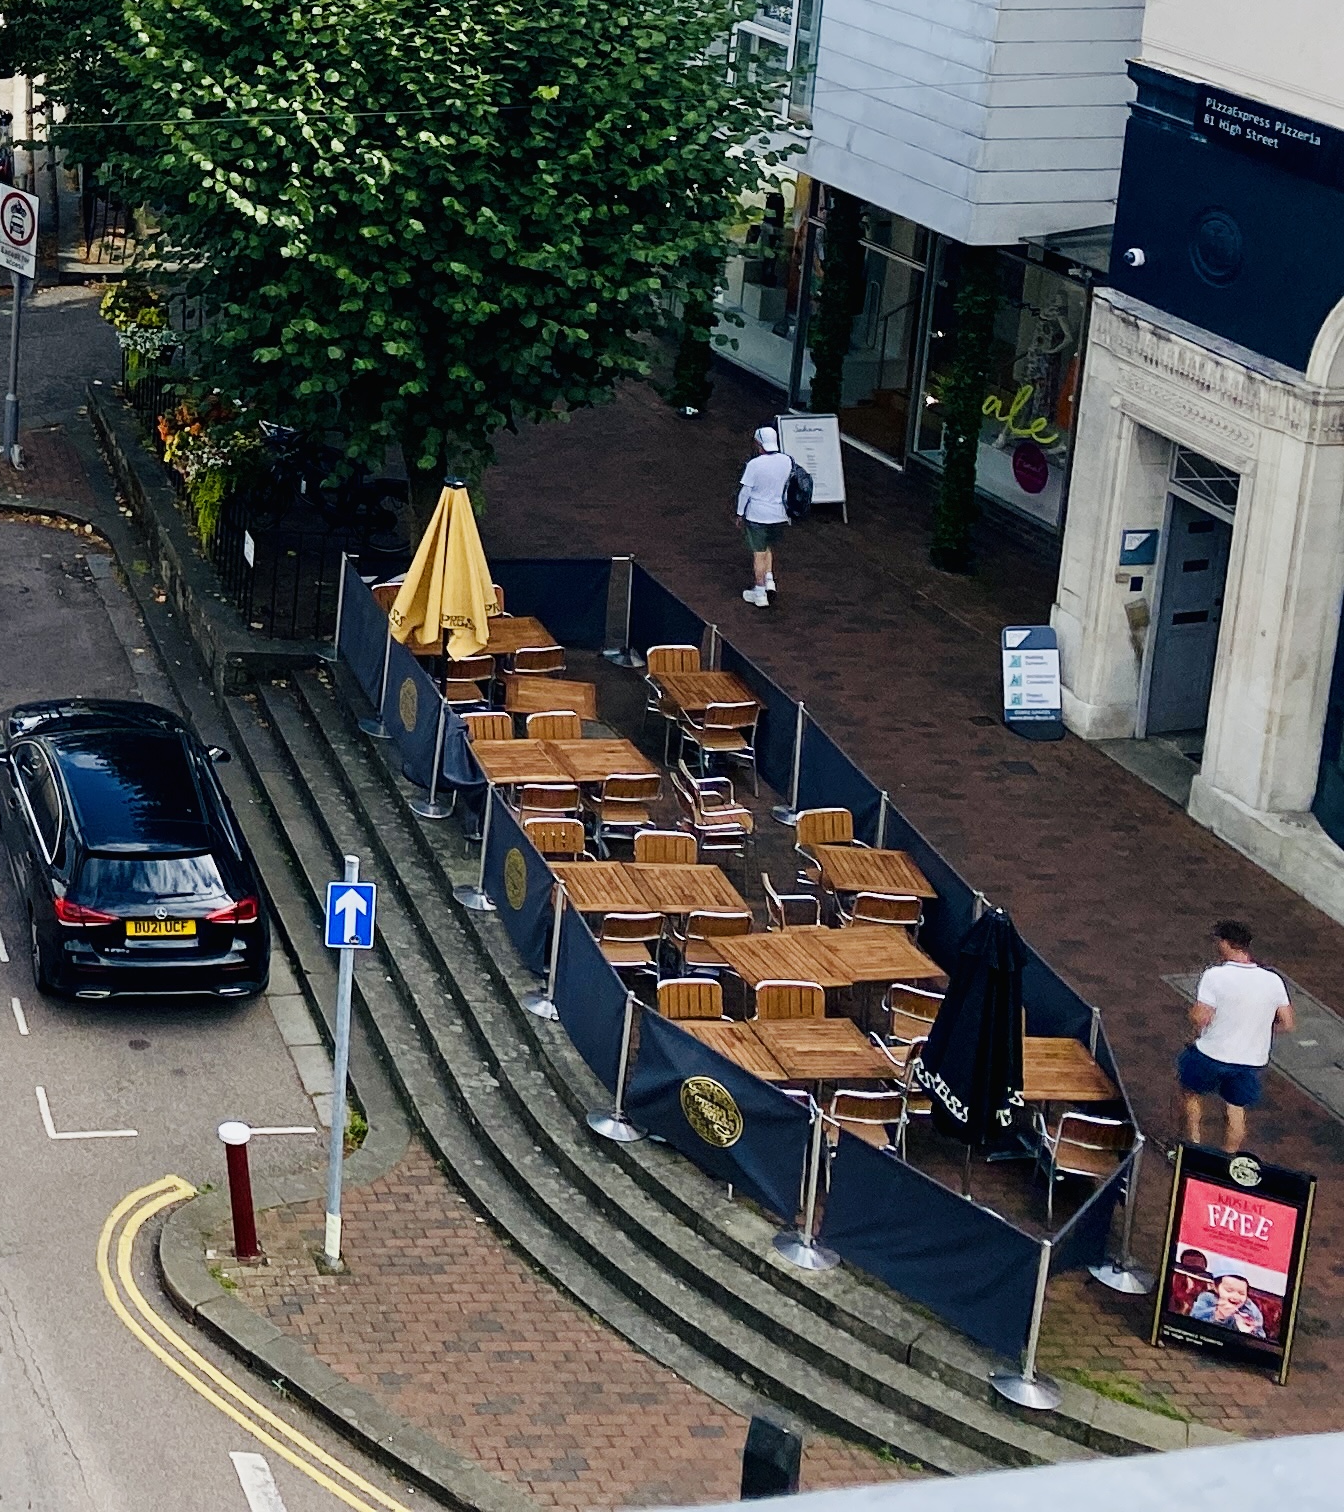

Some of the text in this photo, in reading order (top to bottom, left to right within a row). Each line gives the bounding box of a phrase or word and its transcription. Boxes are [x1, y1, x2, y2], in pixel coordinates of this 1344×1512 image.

[1205, 97, 1321, 146] PizzaExpress Pizzeria
[1219, 119, 1242, 136] High
[1246, 128, 1279, 149] Street
[981, 384, 1059, 444] ale
[1207, 1204, 1274, 1241] FREE
